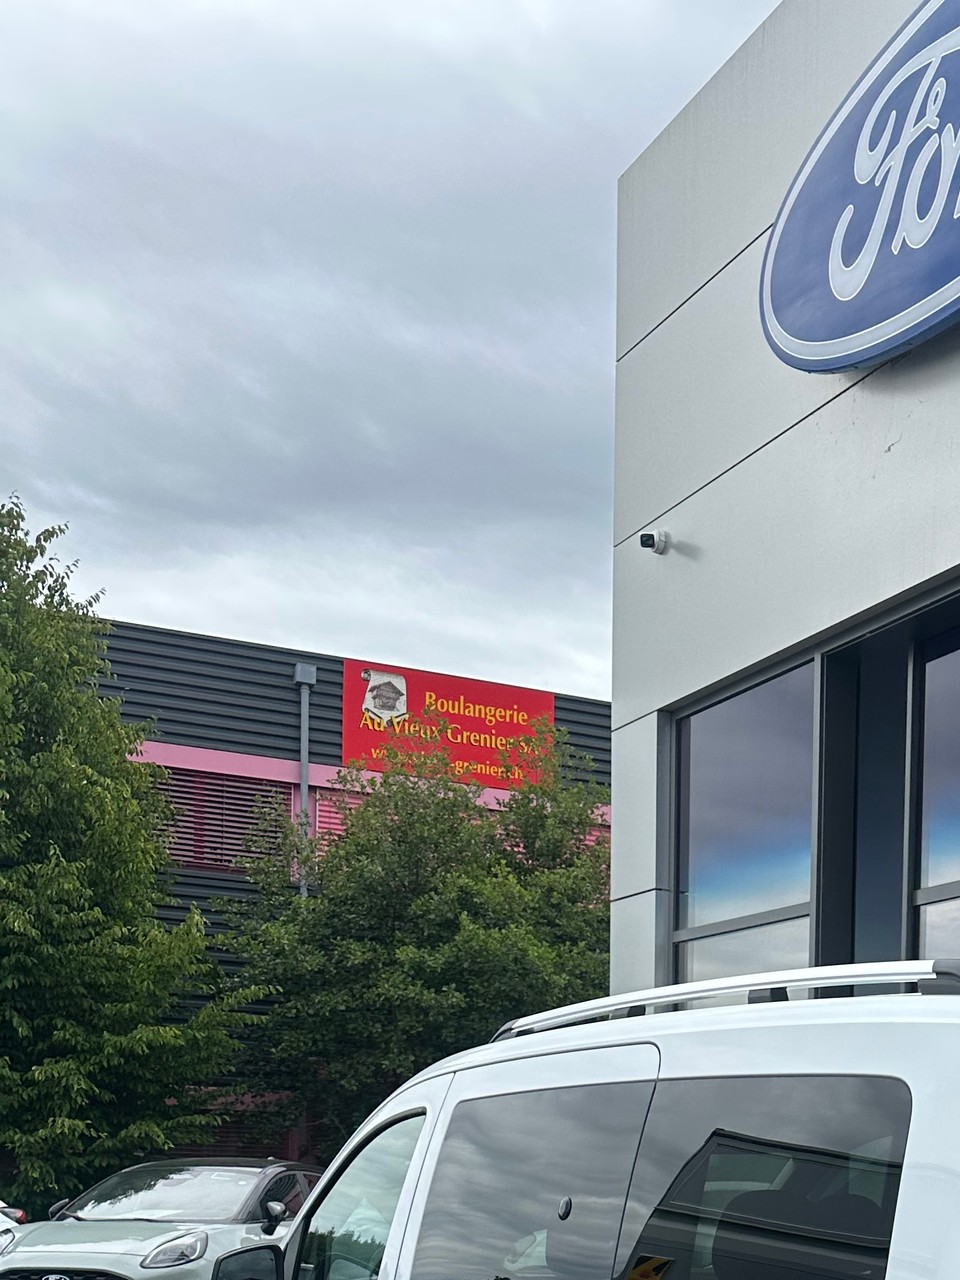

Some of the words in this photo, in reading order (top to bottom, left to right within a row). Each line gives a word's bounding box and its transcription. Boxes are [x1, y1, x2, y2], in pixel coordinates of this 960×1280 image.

[425, 692, 528, 726] Boulangerie
[359, 710, 385, 732] Au
[391, 713, 441, 741] Vieux
[447, 724, 514, 751] Grenier
